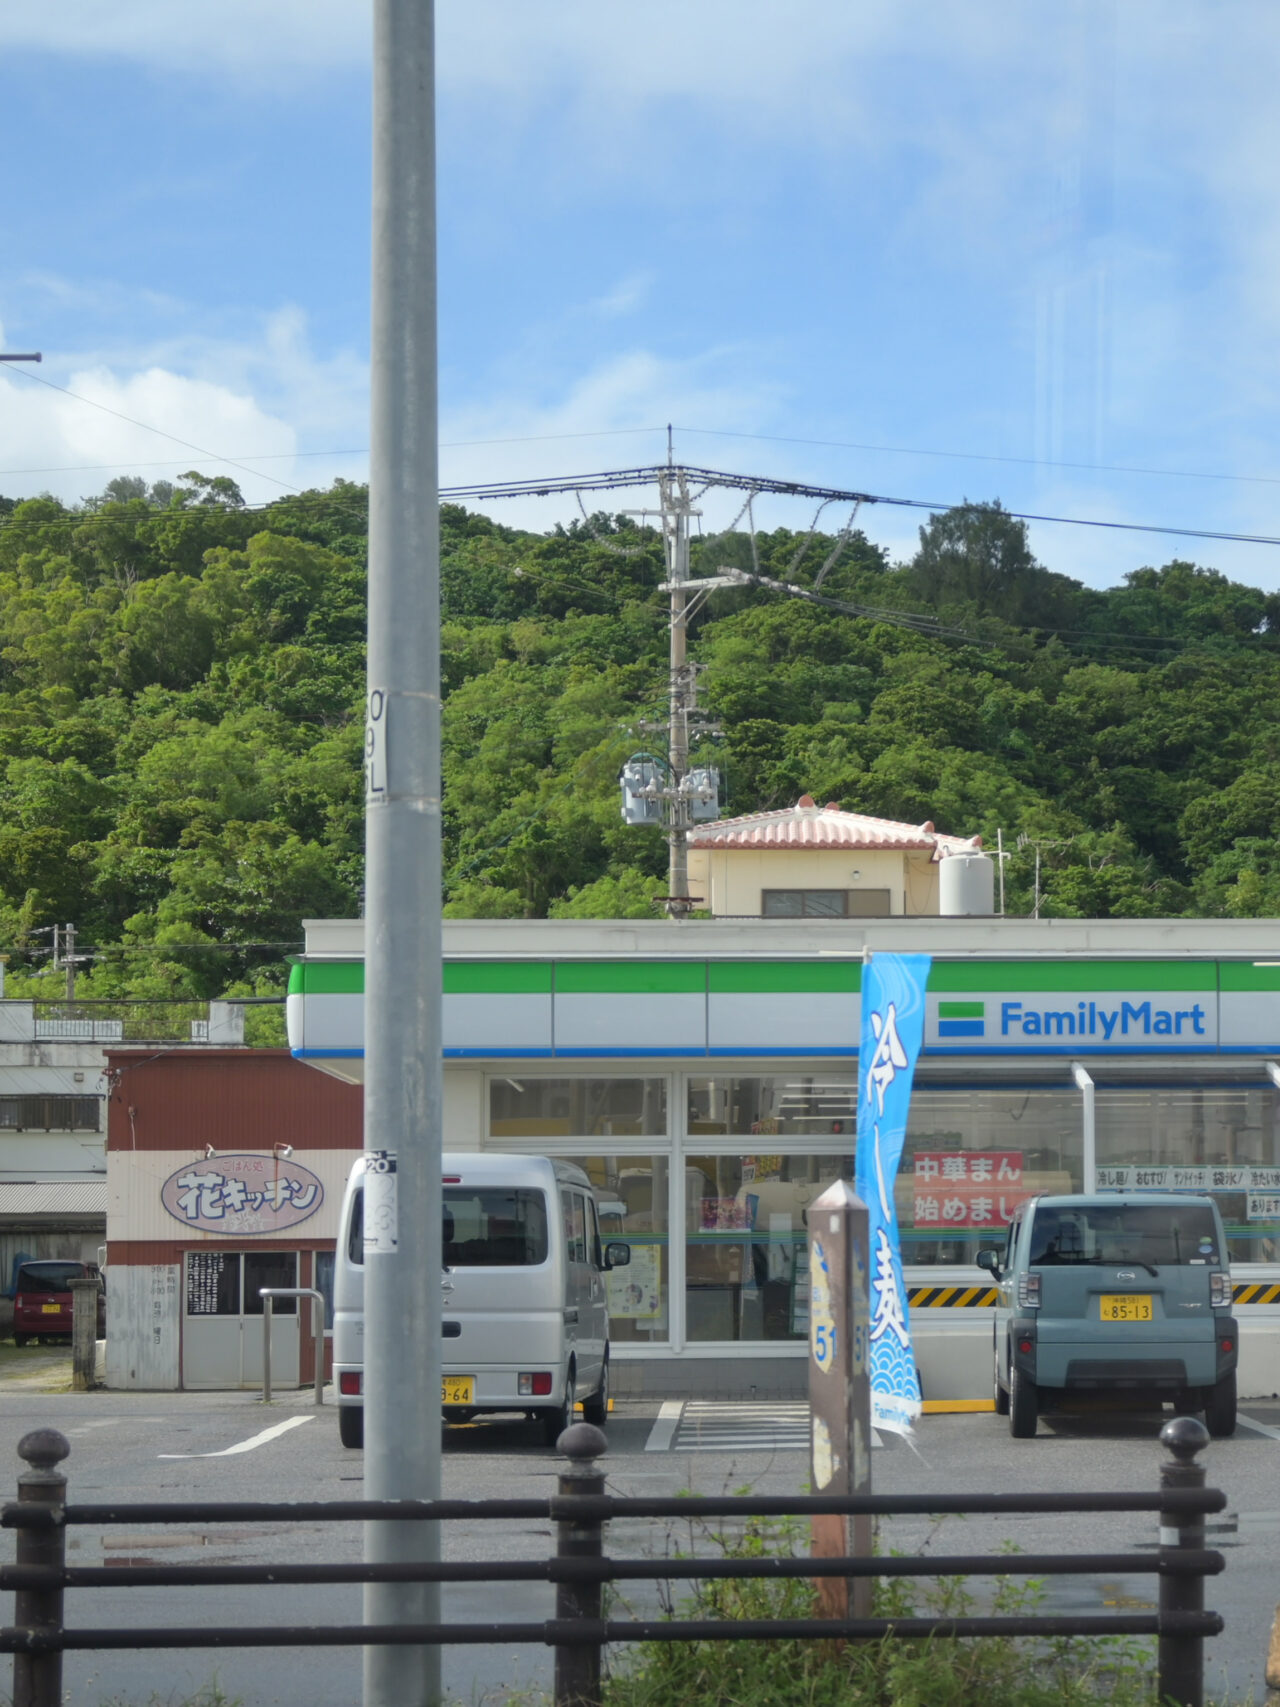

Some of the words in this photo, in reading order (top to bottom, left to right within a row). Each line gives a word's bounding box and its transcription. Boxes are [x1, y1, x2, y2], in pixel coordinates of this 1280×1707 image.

[1001, 1001, 1205, 1041] FamilyMart
[222, 1160, 264, 1172] ごはん処
[915, 1157, 1020, 1182] 中華まん
[176, 1171, 318, 1220] 花キッチン
[1112, 1306, 1149, 1318] 85-13
[815, 1326, 837, 1361] 51
